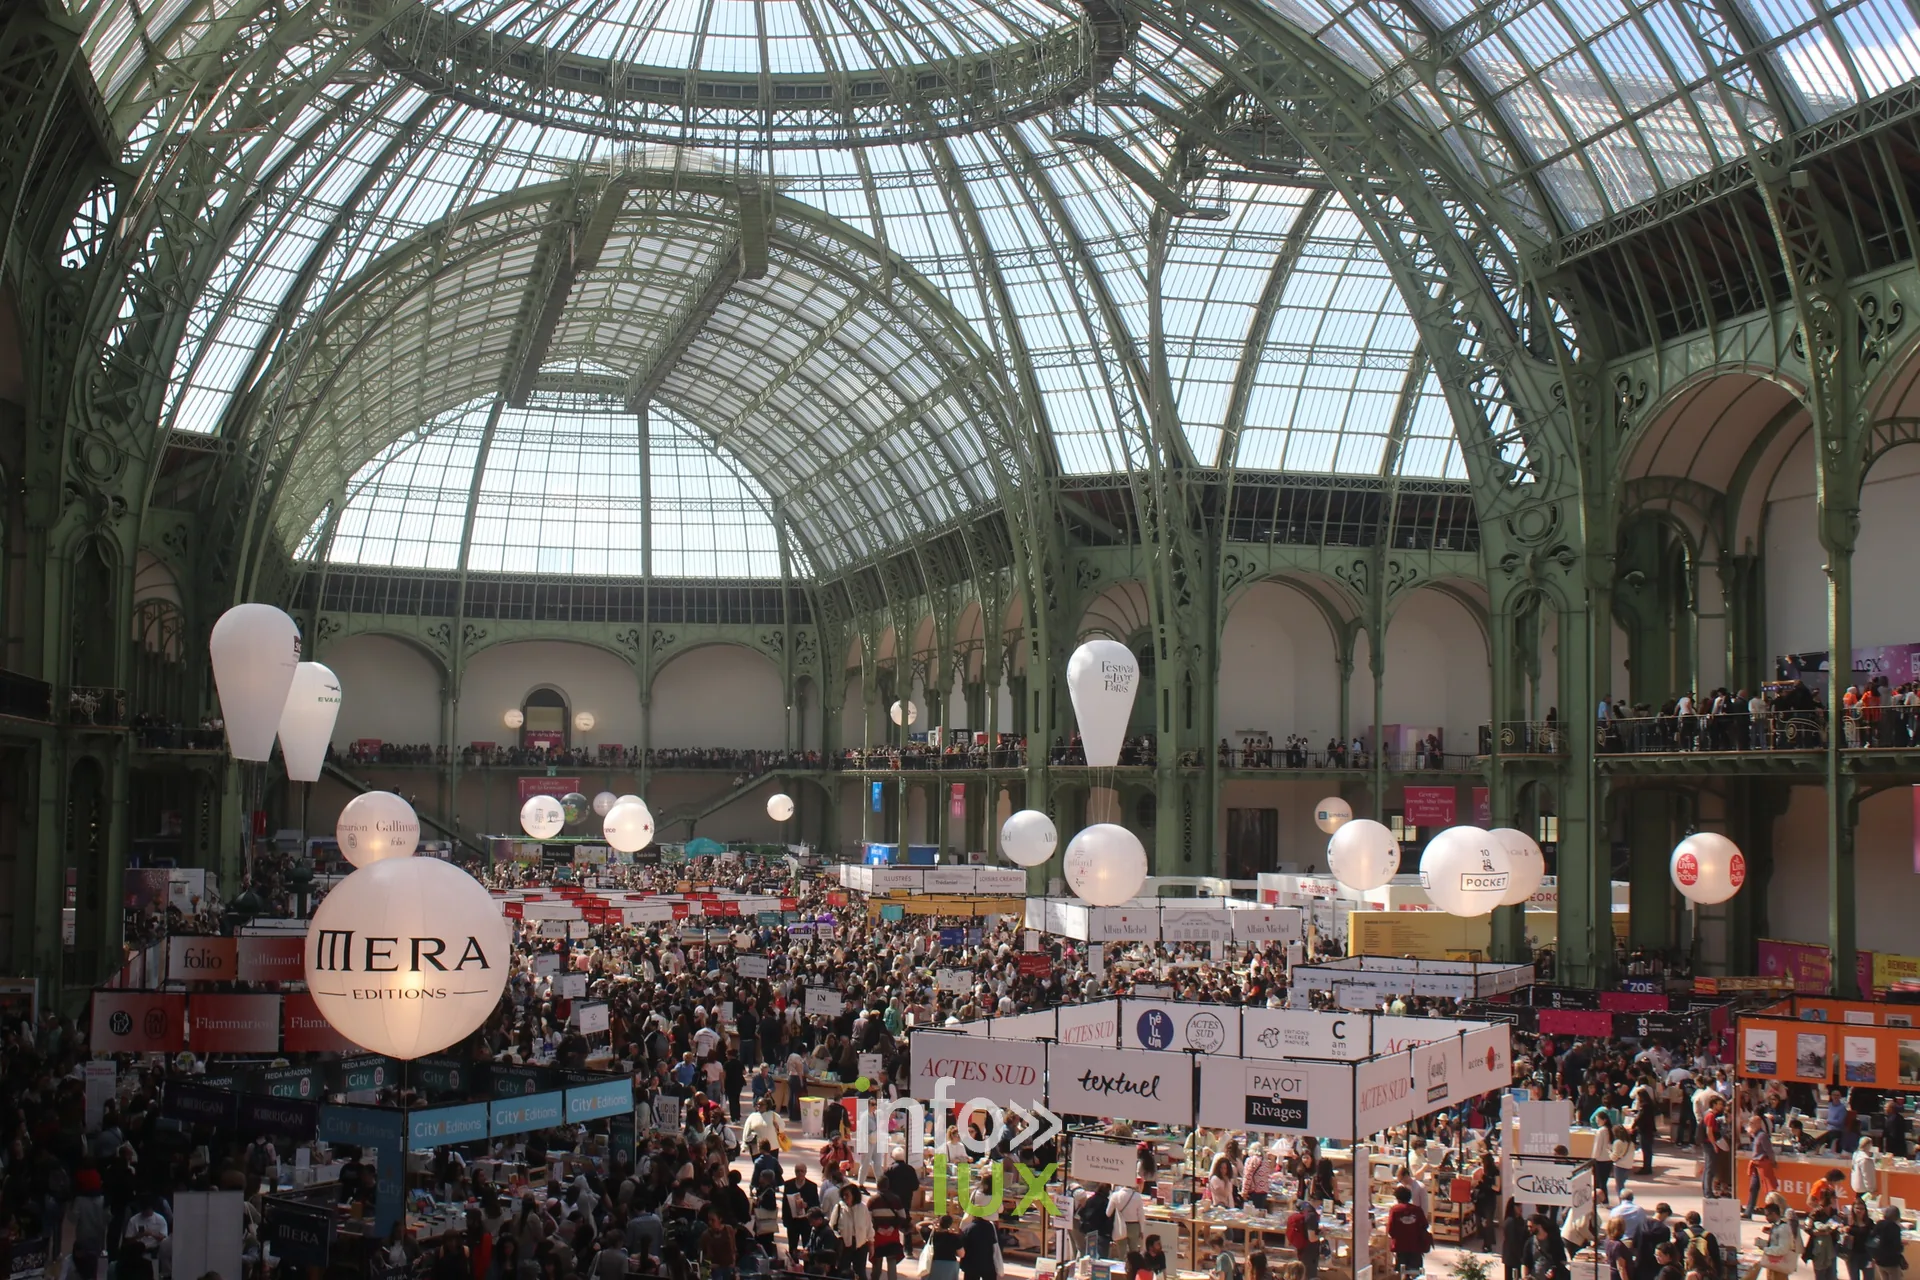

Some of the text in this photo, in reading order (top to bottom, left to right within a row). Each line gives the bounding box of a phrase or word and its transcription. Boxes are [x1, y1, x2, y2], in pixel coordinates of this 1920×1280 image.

[390, 836, 406, 847] folio
[1480, 849, 1490, 857] 10
[1483, 858, 1491, 866] 18
[1678, 861, 1696, 870] Livre
[1466, 876, 1507, 888] POCKET
[1677, 872, 1698, 881] Poche
[1103, 924, 1147, 935] Albin Michel
[1246, 924, 1289, 934] Albin Michel
[316, 929, 491, 972] MERA
[183, 948, 222, 969] folio
[353, 988, 447, 1000] EDITIONS
[1552, 991, 1561, 1000] 10
[195, 1016, 274, 1031] Flammarion
[1190, 1020, 1219, 1030] ACTES
[1637, 1017, 1648, 1027] 10
[1063, 1020, 1115, 1044] ACTES SUD
[1194, 1029, 1214, 1038] SUD
[1332, 1020, 1346, 1040] C
[1638, 1027, 1648, 1037] 18
[1331, 1040, 1347, 1049] am
[341, 1057, 386, 1070] FREIDA McFADDEN
[264, 1067, 312, 1080] FREIDA McFADDEN
[423, 1071, 444, 1084] City
[920, 1057, 1036, 1087] ACTES SUD
[348, 1073, 369, 1087] City
[497, 1079, 519, 1093] City
[1077, 1068, 1162, 1102] textuel
[1253, 1076, 1302, 1093] PAYOT
[272, 1083, 294, 1098] City
[1359, 1082, 1387, 1113] ACTES
[1388, 1077, 1408, 1101] SUD
[571, 1094, 628, 1113] City Editions
[1271, 1092, 1282, 1104] &
[496, 1106, 558, 1126] City Editions
[1252, 1102, 1302, 1122] Rivages
[326, 1116, 351, 1135] City
[414, 1118, 482, 1138] City Editions
[1086, 1155, 1125, 1165] LES MOTS
[377, 1179, 402, 1195] City
[1535, 1175, 1566, 1186] Michel
[278, 1224, 320, 1246] MERA
